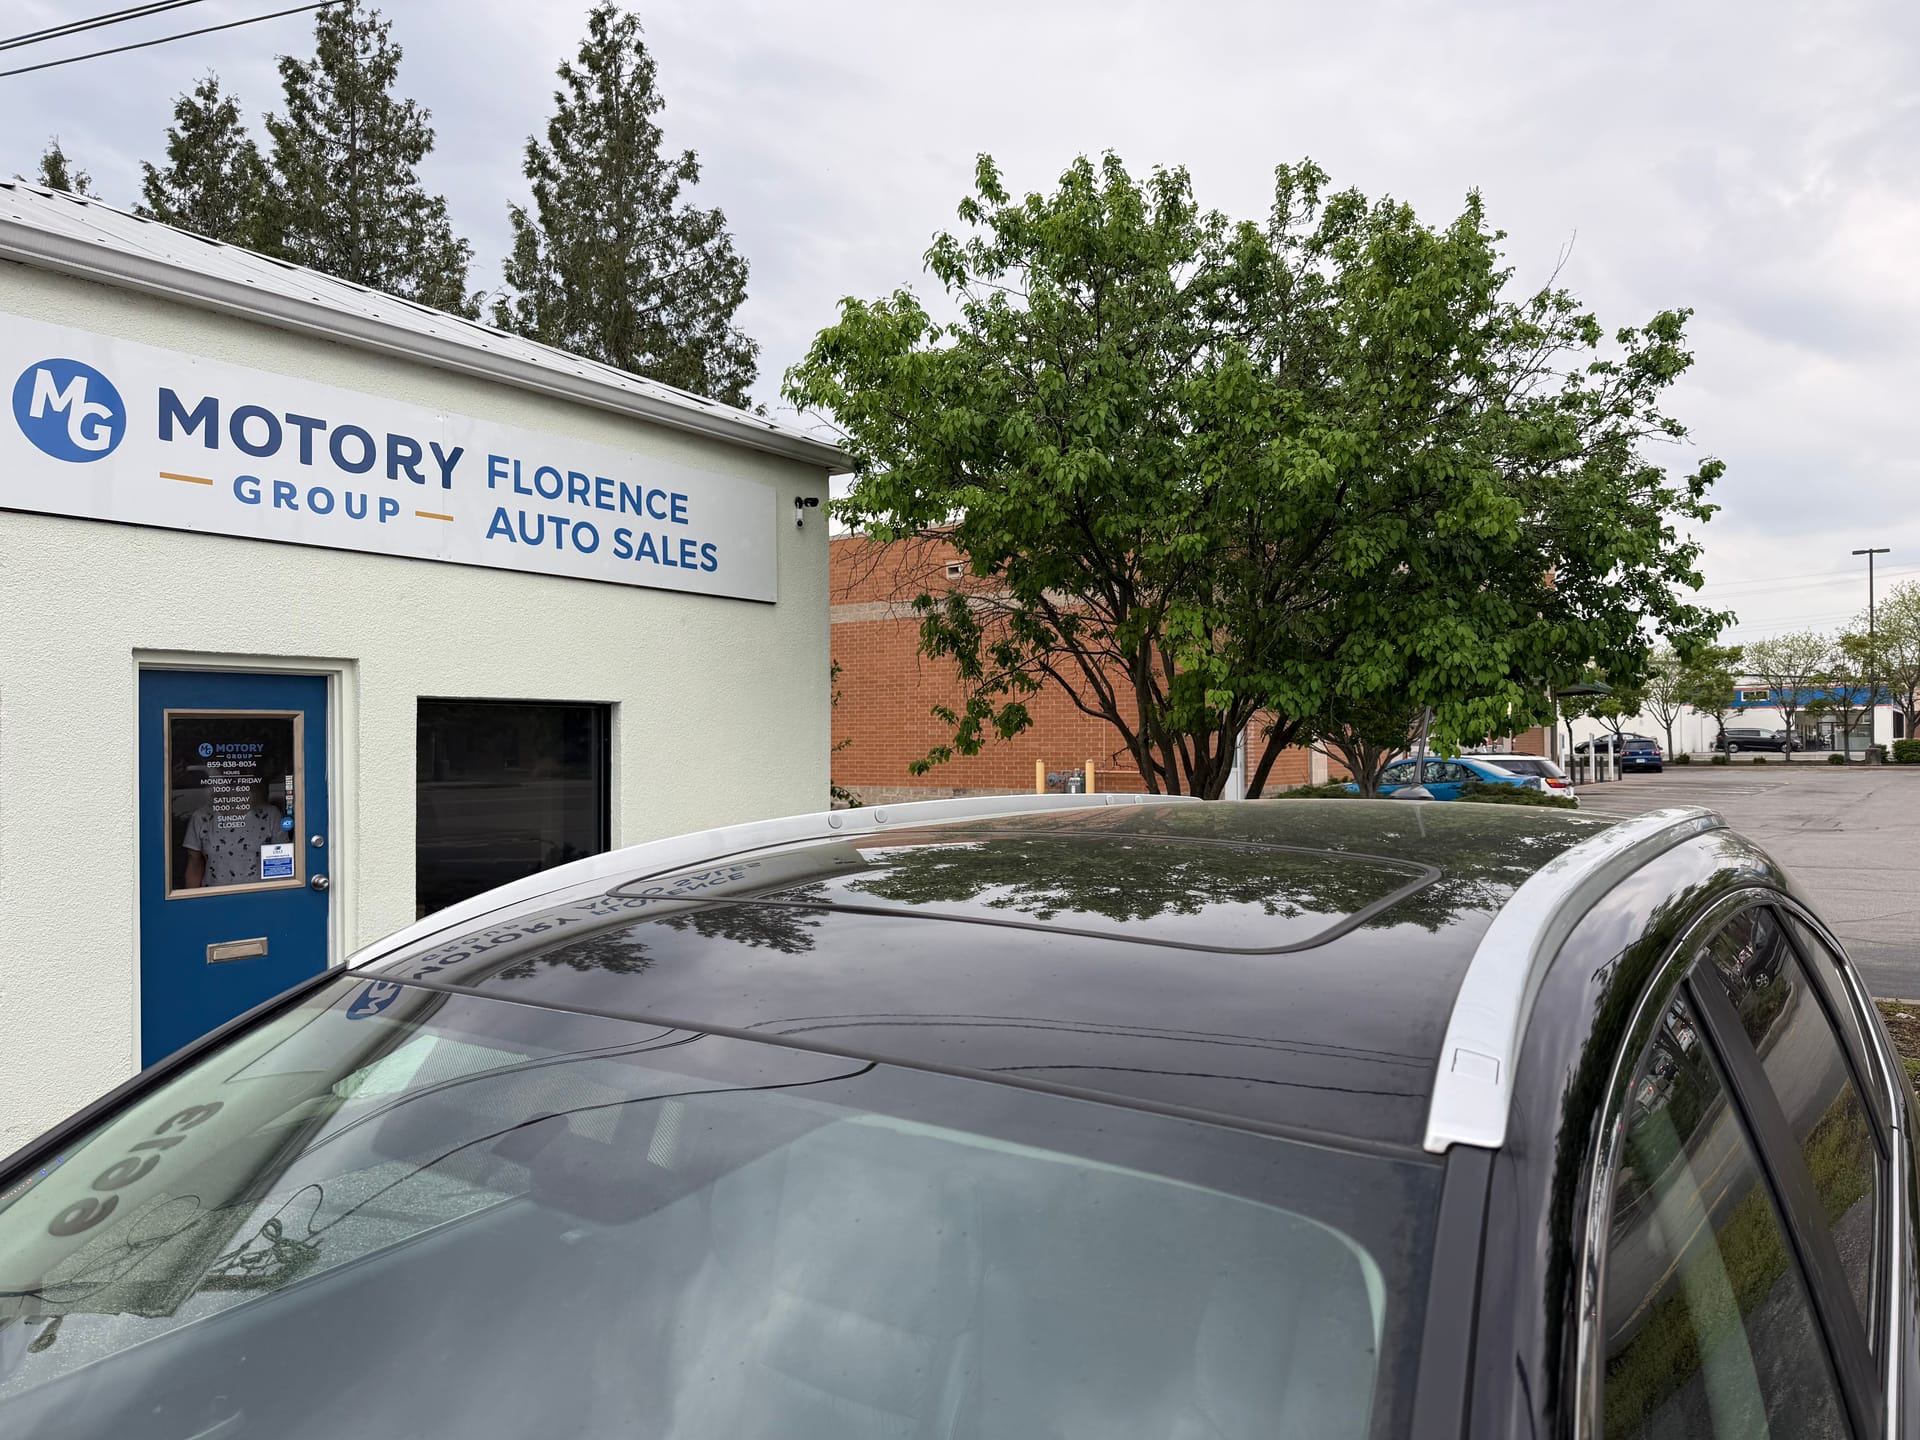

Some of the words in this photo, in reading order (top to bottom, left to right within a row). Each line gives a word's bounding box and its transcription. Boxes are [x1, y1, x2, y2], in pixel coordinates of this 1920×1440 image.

[27, 366, 115, 453] MG
[157, 387, 465, 490] MOTORY
[232, 474, 401, 524] GROUP
[487, 454, 690, 526] FLORENCE
[485, 506, 601, 555] AUTO
[612, 527, 719, 573] SALES
[216, 743, 264, 753] MOTORY
[213, 796, 250, 804] SATURDAY
[217, 821, 246, 829] CLOSED
